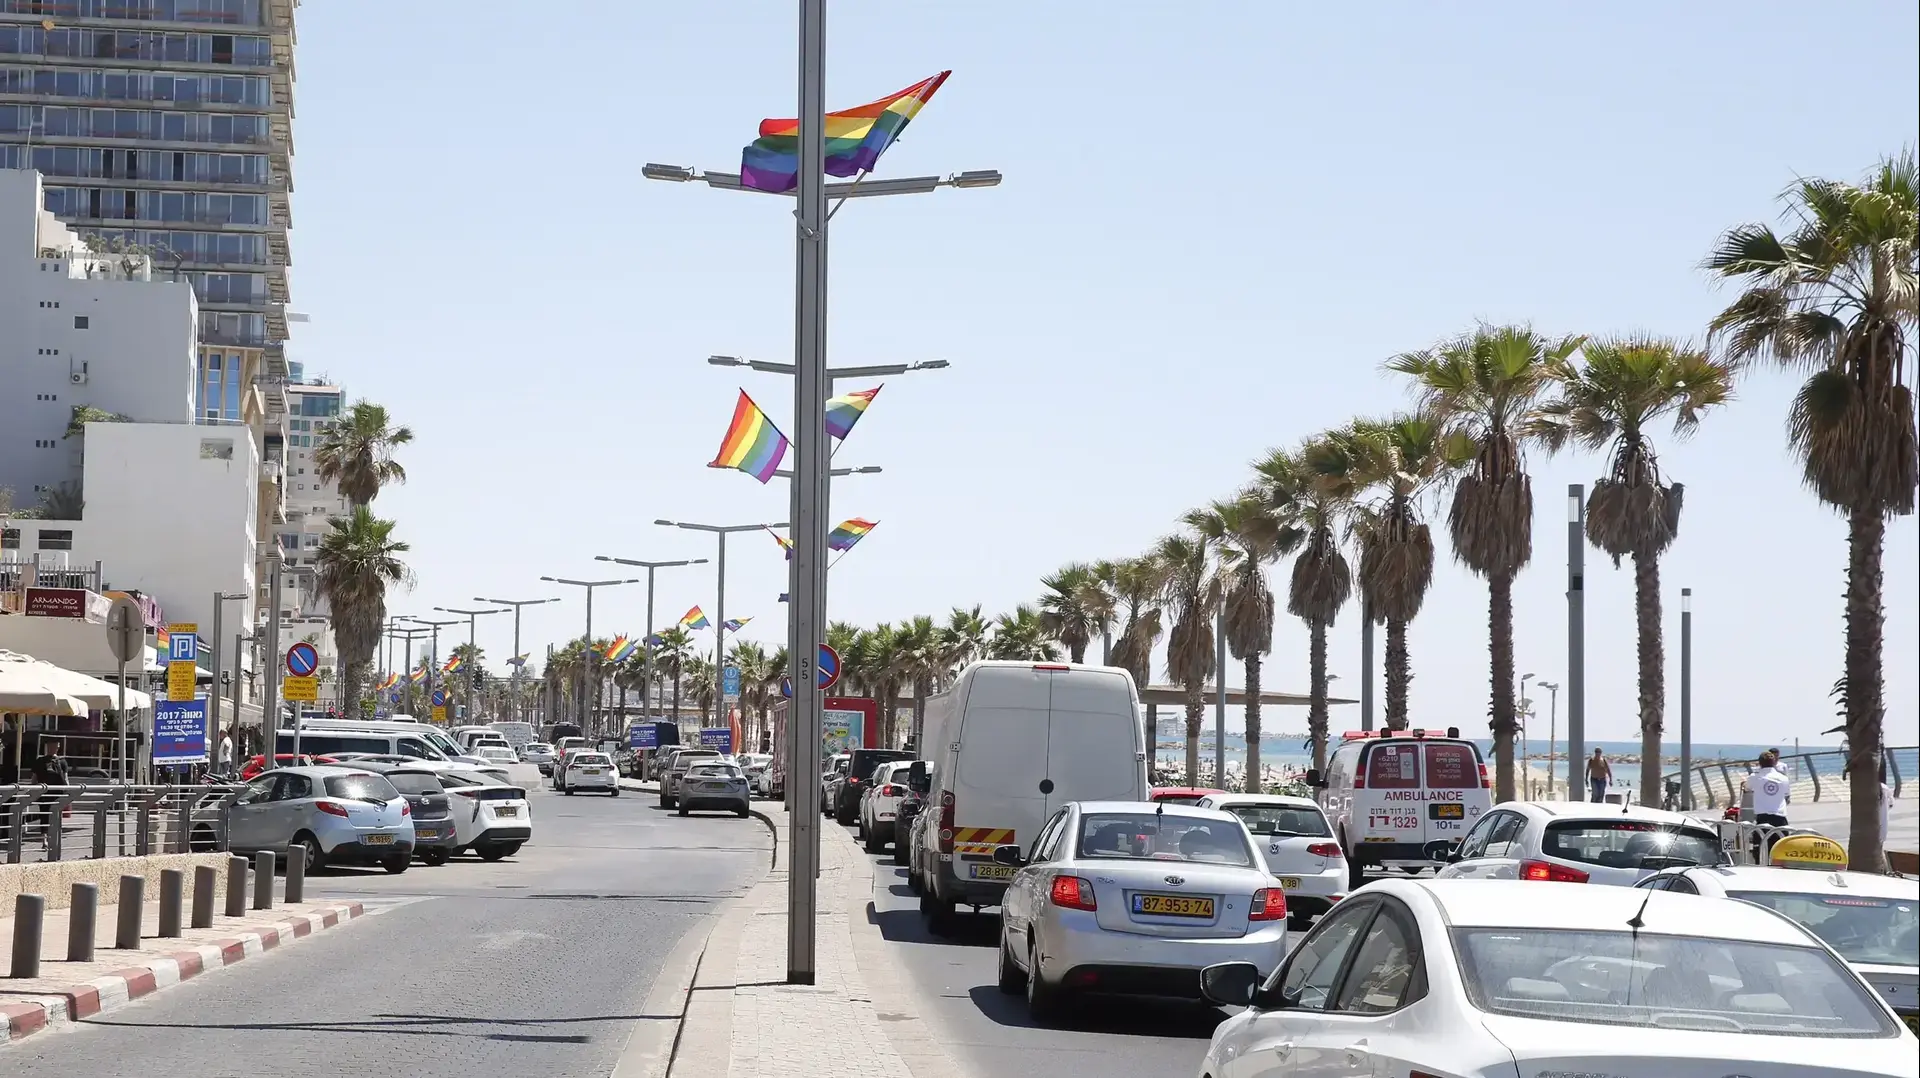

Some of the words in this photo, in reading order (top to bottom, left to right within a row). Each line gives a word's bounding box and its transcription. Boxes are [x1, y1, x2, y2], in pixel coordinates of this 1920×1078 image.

[32, 596, 78, 605] ARMANDO
[156, 711, 180, 720] 2017
[181, 710, 203, 719] גאווה
[1384, 790, 1464, 801] AMBULANCE
[1370, 807, 1387, 815] אדום
[1404, 807, 1416, 816] מגן
[1392, 816, 1418, 829] 1329
[1435, 820, 1453, 830] 101
